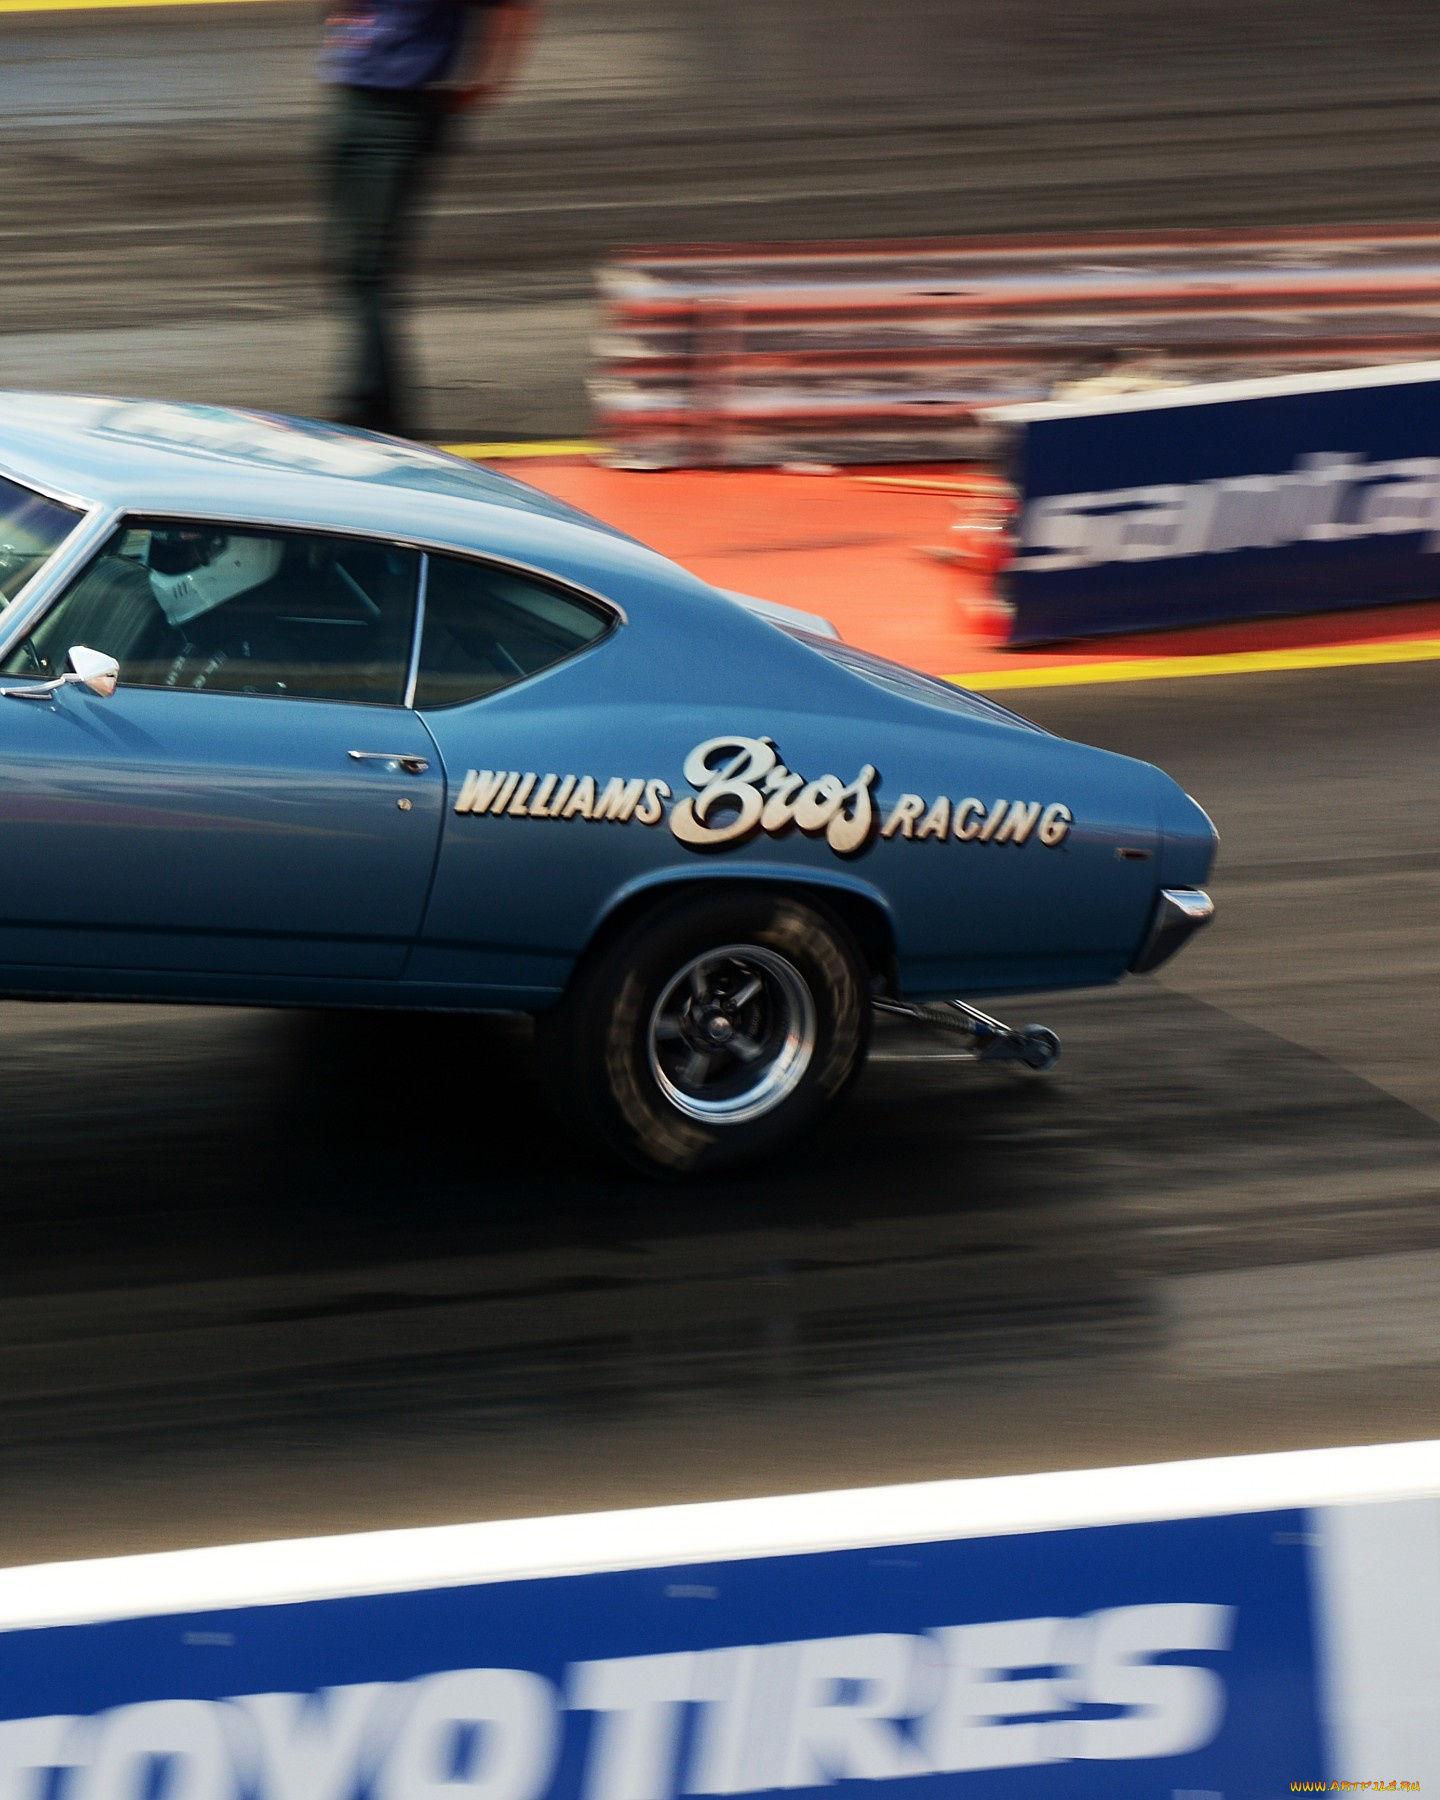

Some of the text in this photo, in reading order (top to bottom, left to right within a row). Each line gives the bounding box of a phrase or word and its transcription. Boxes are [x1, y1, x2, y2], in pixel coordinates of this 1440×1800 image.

[1015, 451, 1440, 572] santa
[454, 735, 1073, 854] WILLIAMS Bros RACING
[561, 1602, 1238, 1800] TIRES
